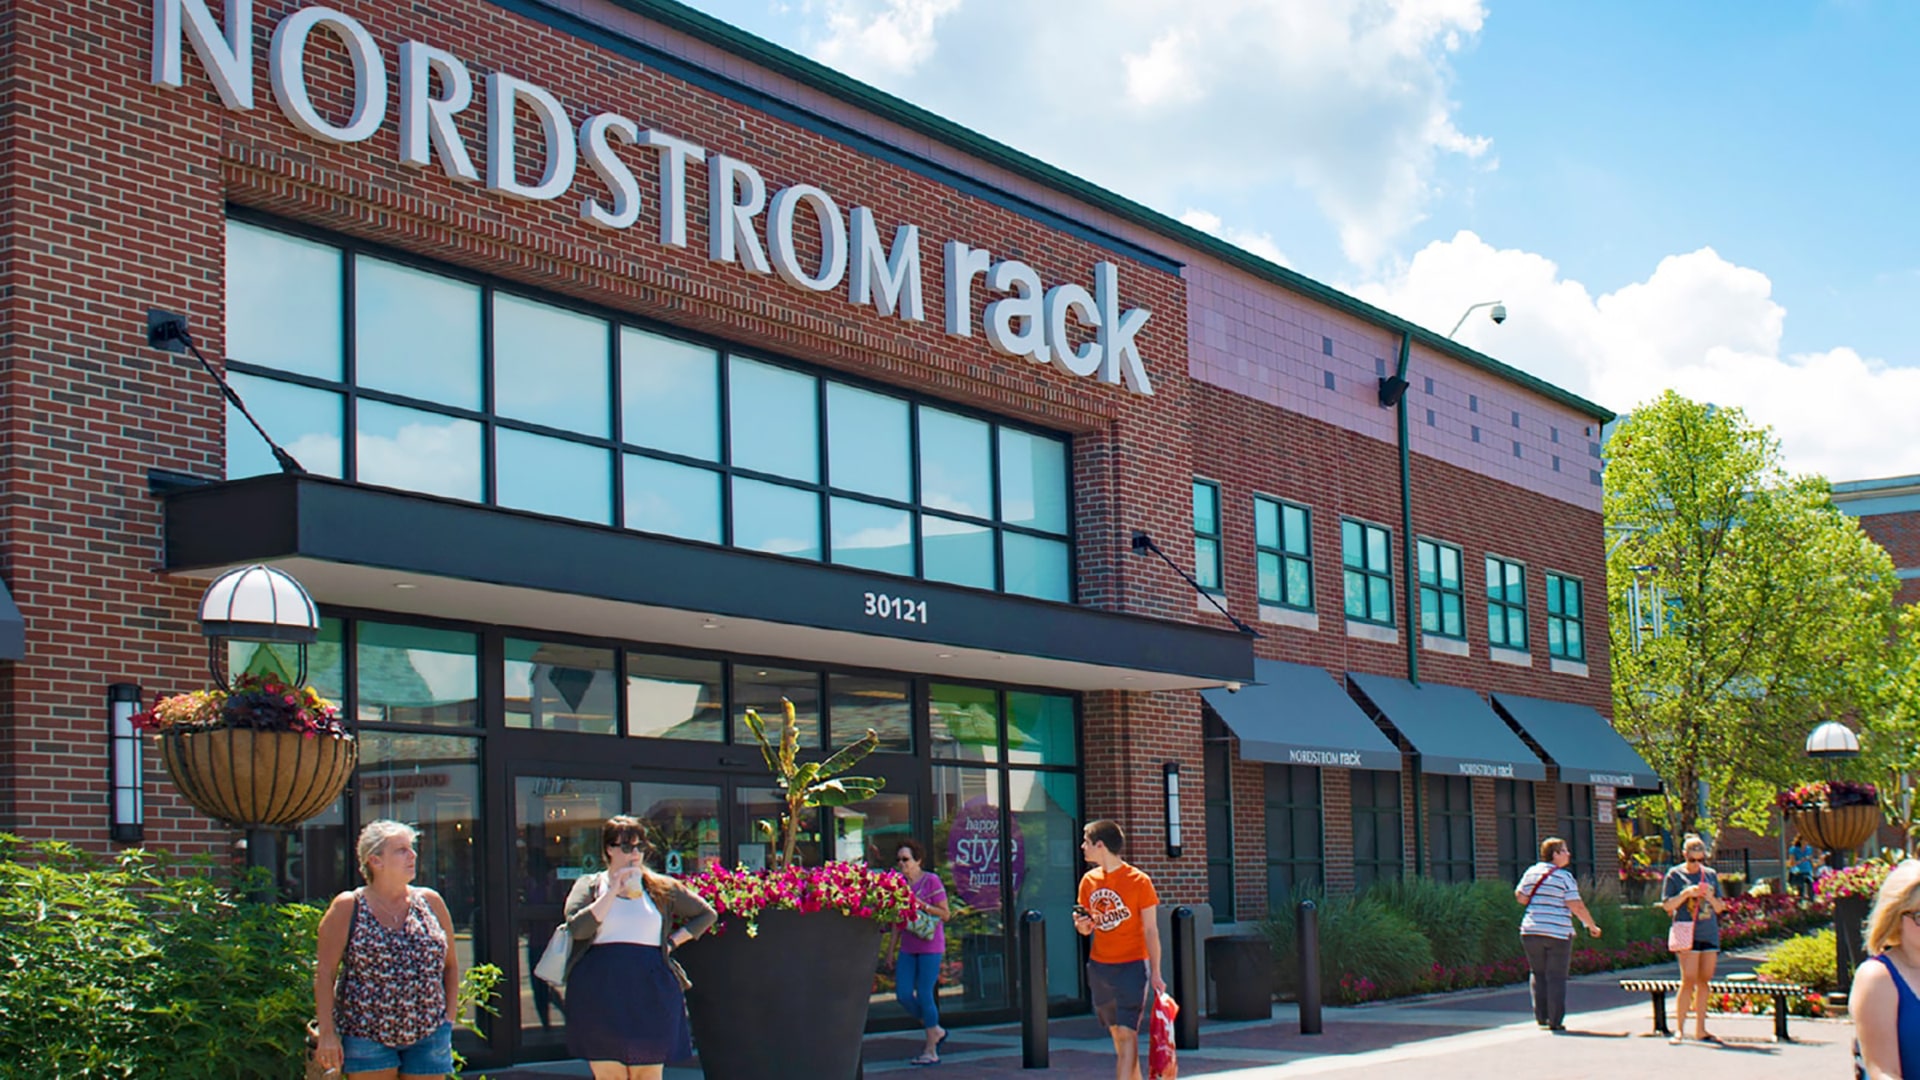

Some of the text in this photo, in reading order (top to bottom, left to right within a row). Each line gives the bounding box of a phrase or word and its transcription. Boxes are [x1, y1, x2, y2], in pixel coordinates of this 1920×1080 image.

[151, 0, 1155, 396] NORDSTROM rack
[863, 592, 928, 624] 30121
[1340, 749, 1361, 766] rack
